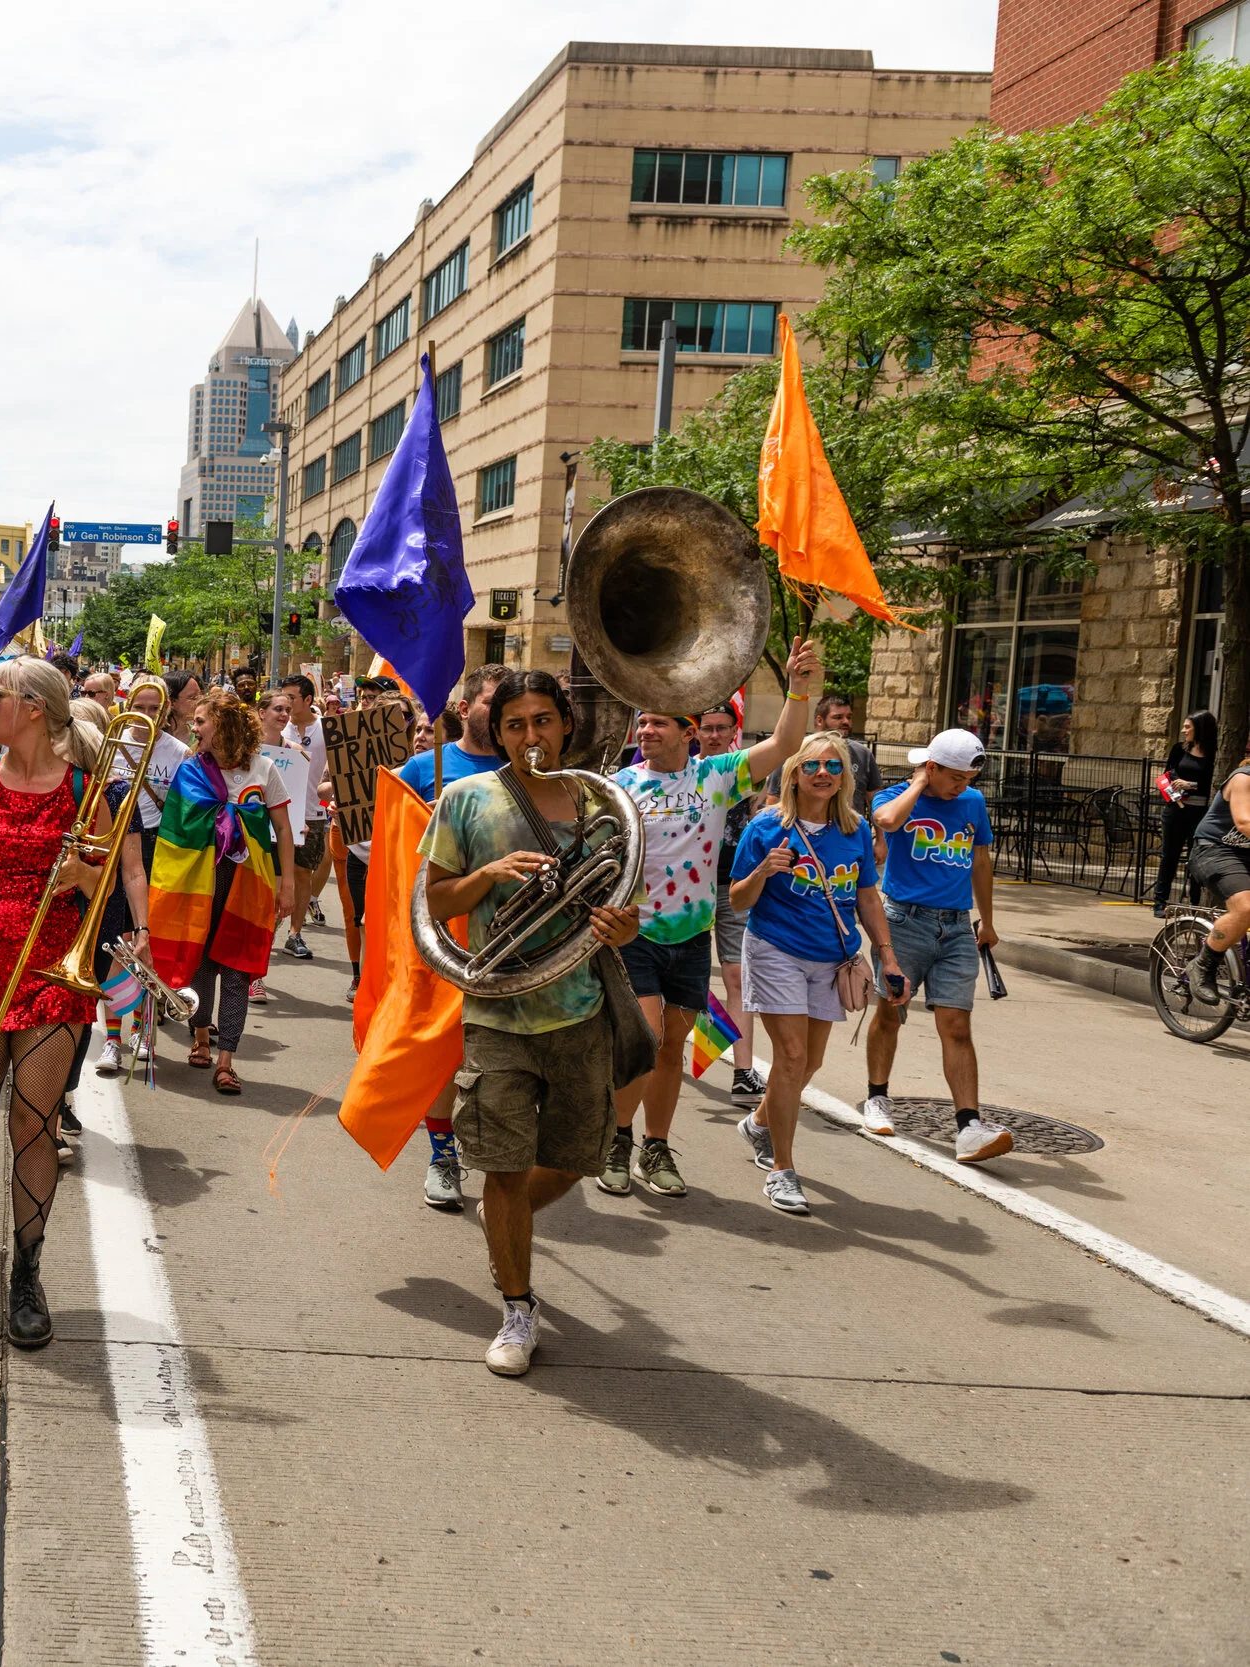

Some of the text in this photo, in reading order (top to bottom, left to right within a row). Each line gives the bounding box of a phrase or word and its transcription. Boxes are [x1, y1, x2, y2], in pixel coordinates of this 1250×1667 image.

[80, 532, 99, 540] Gen
[102, 532, 144, 541] Robinson
[147, 534, 158, 542] St
[494, 591, 516, 601] TICKETS
[500, 605, 509, 617] P
[322, 704, 402, 746] BLACK
[327, 730, 408, 775] TRANS
[904, 818, 976, 869] Pitt
